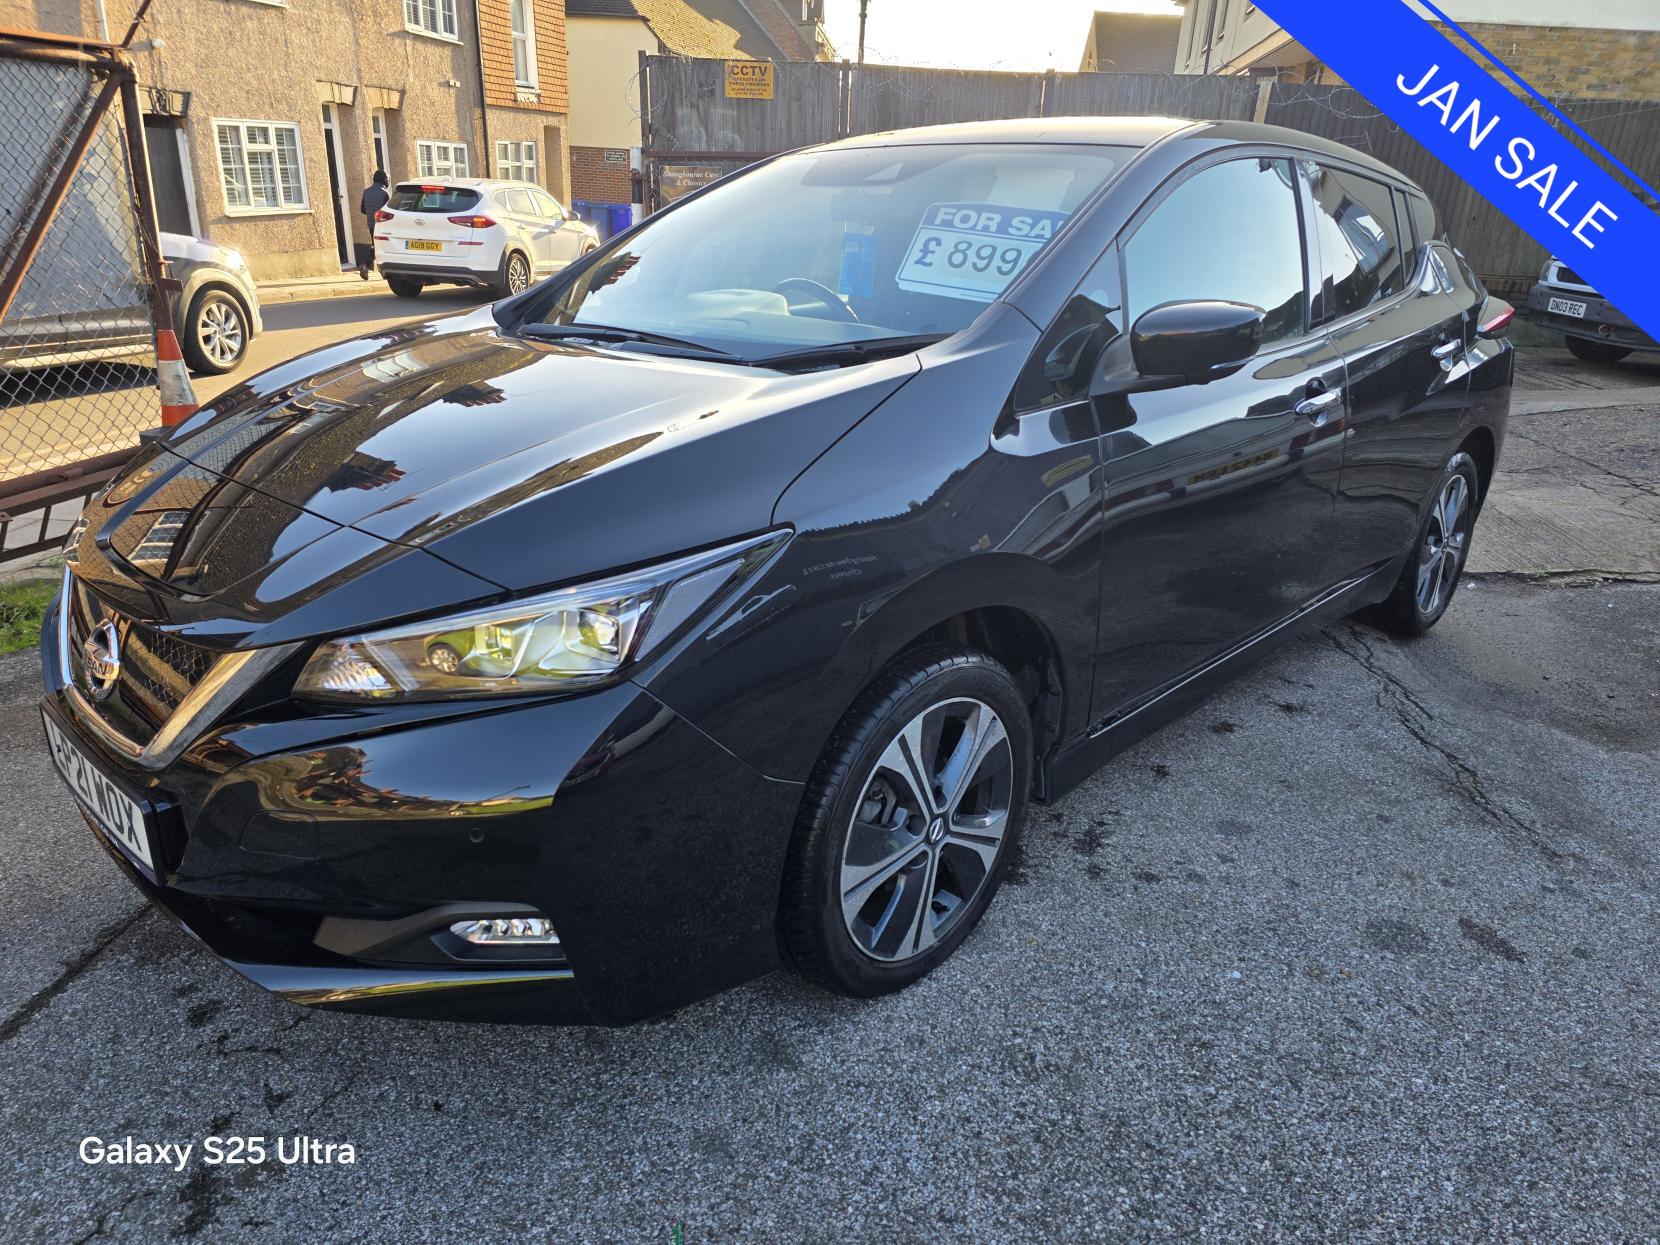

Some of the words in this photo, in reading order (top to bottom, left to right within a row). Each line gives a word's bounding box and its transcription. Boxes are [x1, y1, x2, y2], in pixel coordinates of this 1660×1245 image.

[731, 65, 768, 76] CCTV
[934, 207, 1002, 233] FOR
[426, 242, 439, 250] GGY
[1568, 303, 1583, 316] REC
[90, 765, 142, 853] WOX
